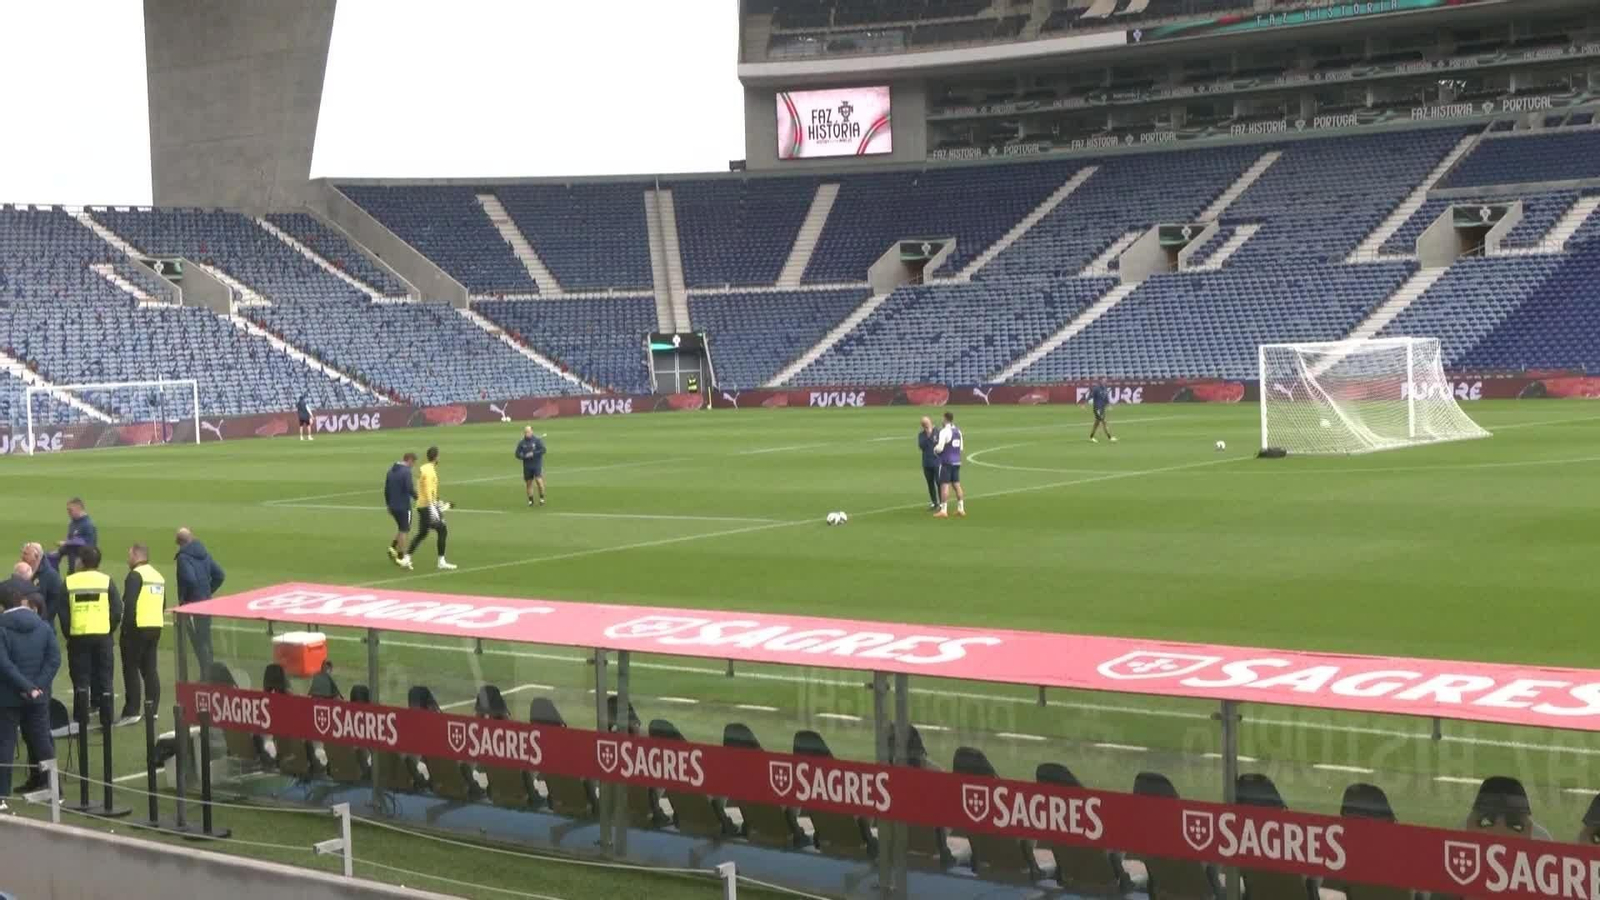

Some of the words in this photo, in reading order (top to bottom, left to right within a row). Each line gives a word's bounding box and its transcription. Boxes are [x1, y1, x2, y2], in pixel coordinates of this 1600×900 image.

[811, 109, 832, 124] FAZ
[1313, 114, 1359, 128] PORTUGAL
[1411, 108, 1428, 120] FAZ
[1502, 96, 1553, 112] PORTUGAL
[808, 121, 860, 140] HISTÓRIA
[1004, 143, 1041, 155] PORTUGAL
[1140, 131, 1177, 144] PORTUGAL
[659, 619, 1002, 664] SAGRES
[212, 692, 271, 729] SAGRES
[332, 709, 398, 746] SAGRES
[468, 724, 542, 765] SAGRES
[620, 741, 704, 787] SAGRES
[796, 763, 891, 812] SAGRES
[993, 786, 1103, 840] SAGRES
[1218, 812, 1347, 871] SAGRES
